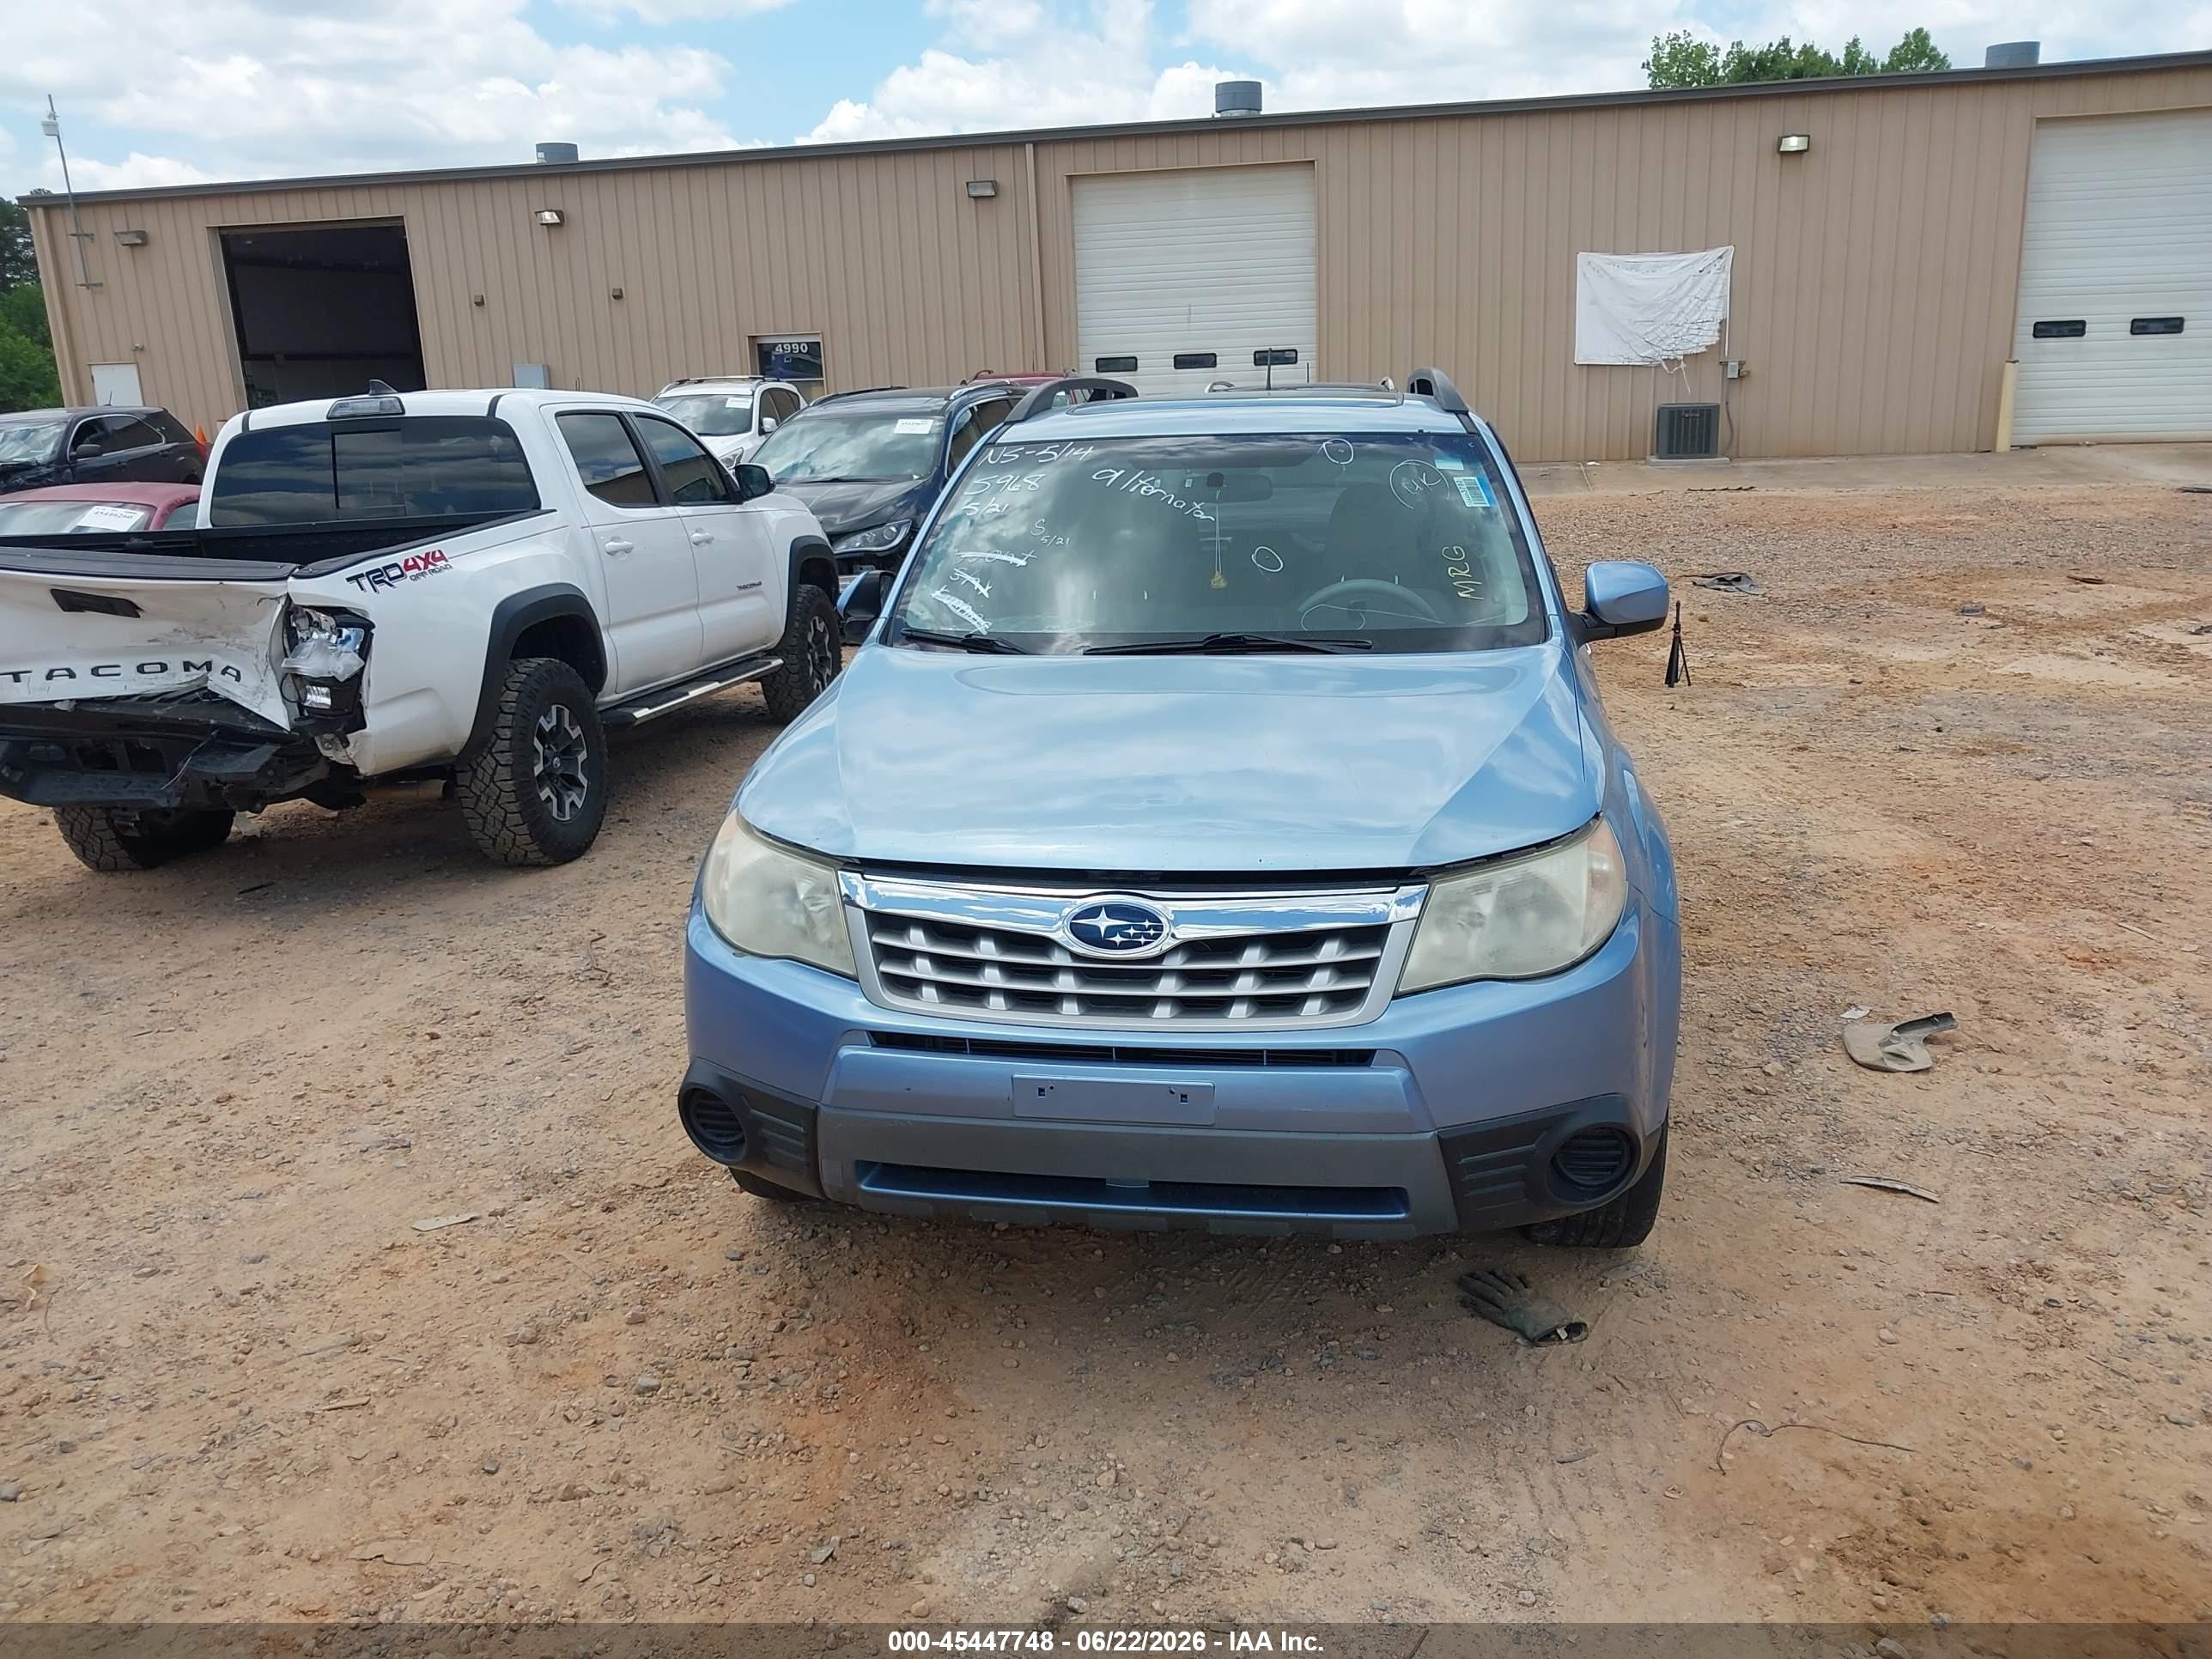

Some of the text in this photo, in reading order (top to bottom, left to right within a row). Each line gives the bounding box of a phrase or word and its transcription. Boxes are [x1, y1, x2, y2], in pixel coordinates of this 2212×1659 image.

[775, 343, 809, 354] 4990
[963, 473, 1046, 495] 5968
[962, 497, 1010, 516] 5/21
[1041, 535, 1071, 548] 5/21
[409, 564, 452, 581] OFF ROAD
[0, 659, 242, 684] TACOMA
